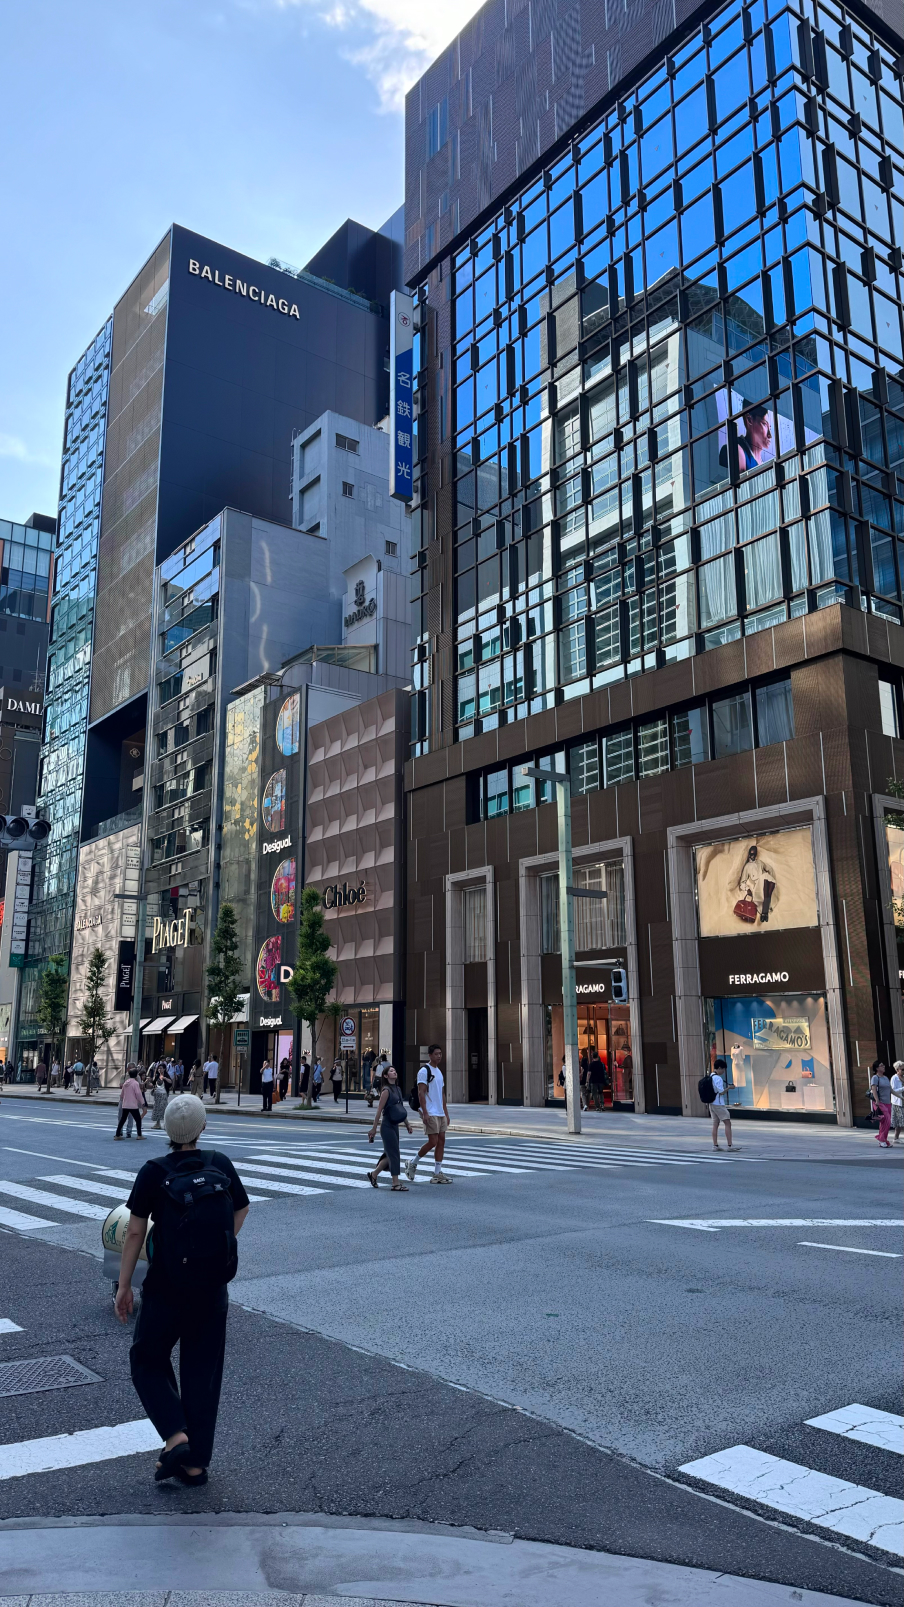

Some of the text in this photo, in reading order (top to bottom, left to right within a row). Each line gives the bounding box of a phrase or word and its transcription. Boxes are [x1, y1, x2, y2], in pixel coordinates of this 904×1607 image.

[188, 258, 301, 320] BALENCIAGA
[397, 371, 411, 479] 名鉄観光
[322, 879, 367, 910] Chloé
[152, 908, 193, 954] PIAGET
[119, 963, 132, 988] PIAGET
[728, 971, 790, 986] FERRAGAMO
